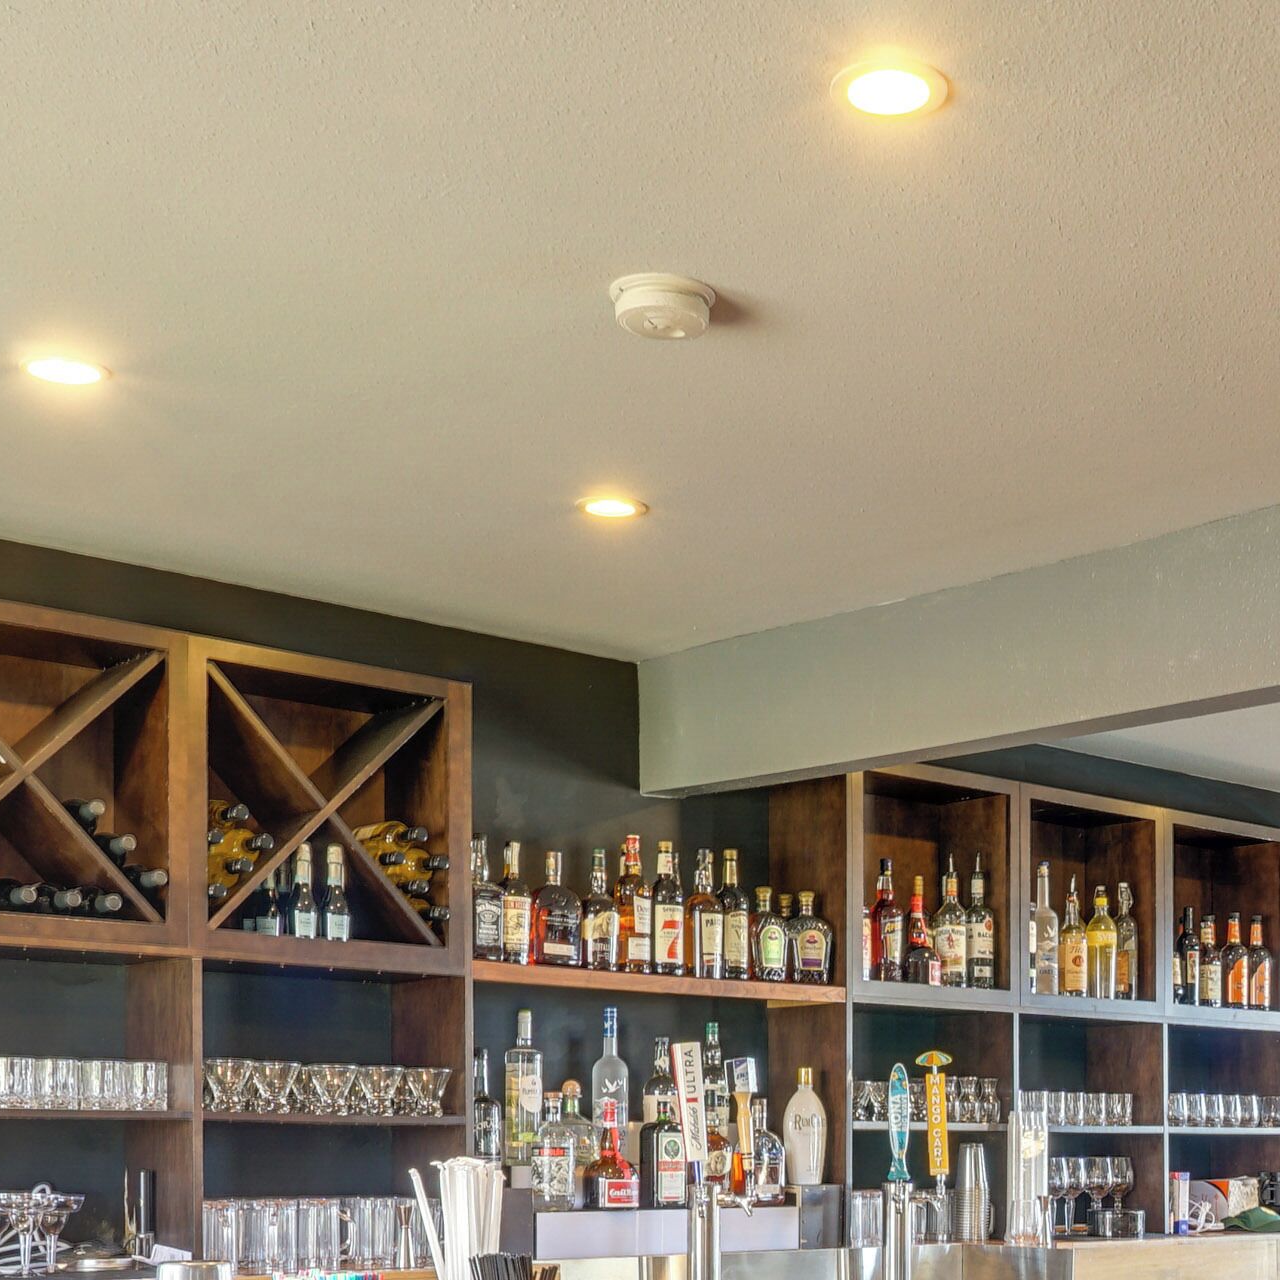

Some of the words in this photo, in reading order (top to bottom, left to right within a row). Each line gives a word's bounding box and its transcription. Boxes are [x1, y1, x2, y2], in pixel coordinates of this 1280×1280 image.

[684, 1049, 697, 1095] ULTRA
[930, 1076, 941, 1124] MANGO
[932, 1128, 943, 1167] CART
